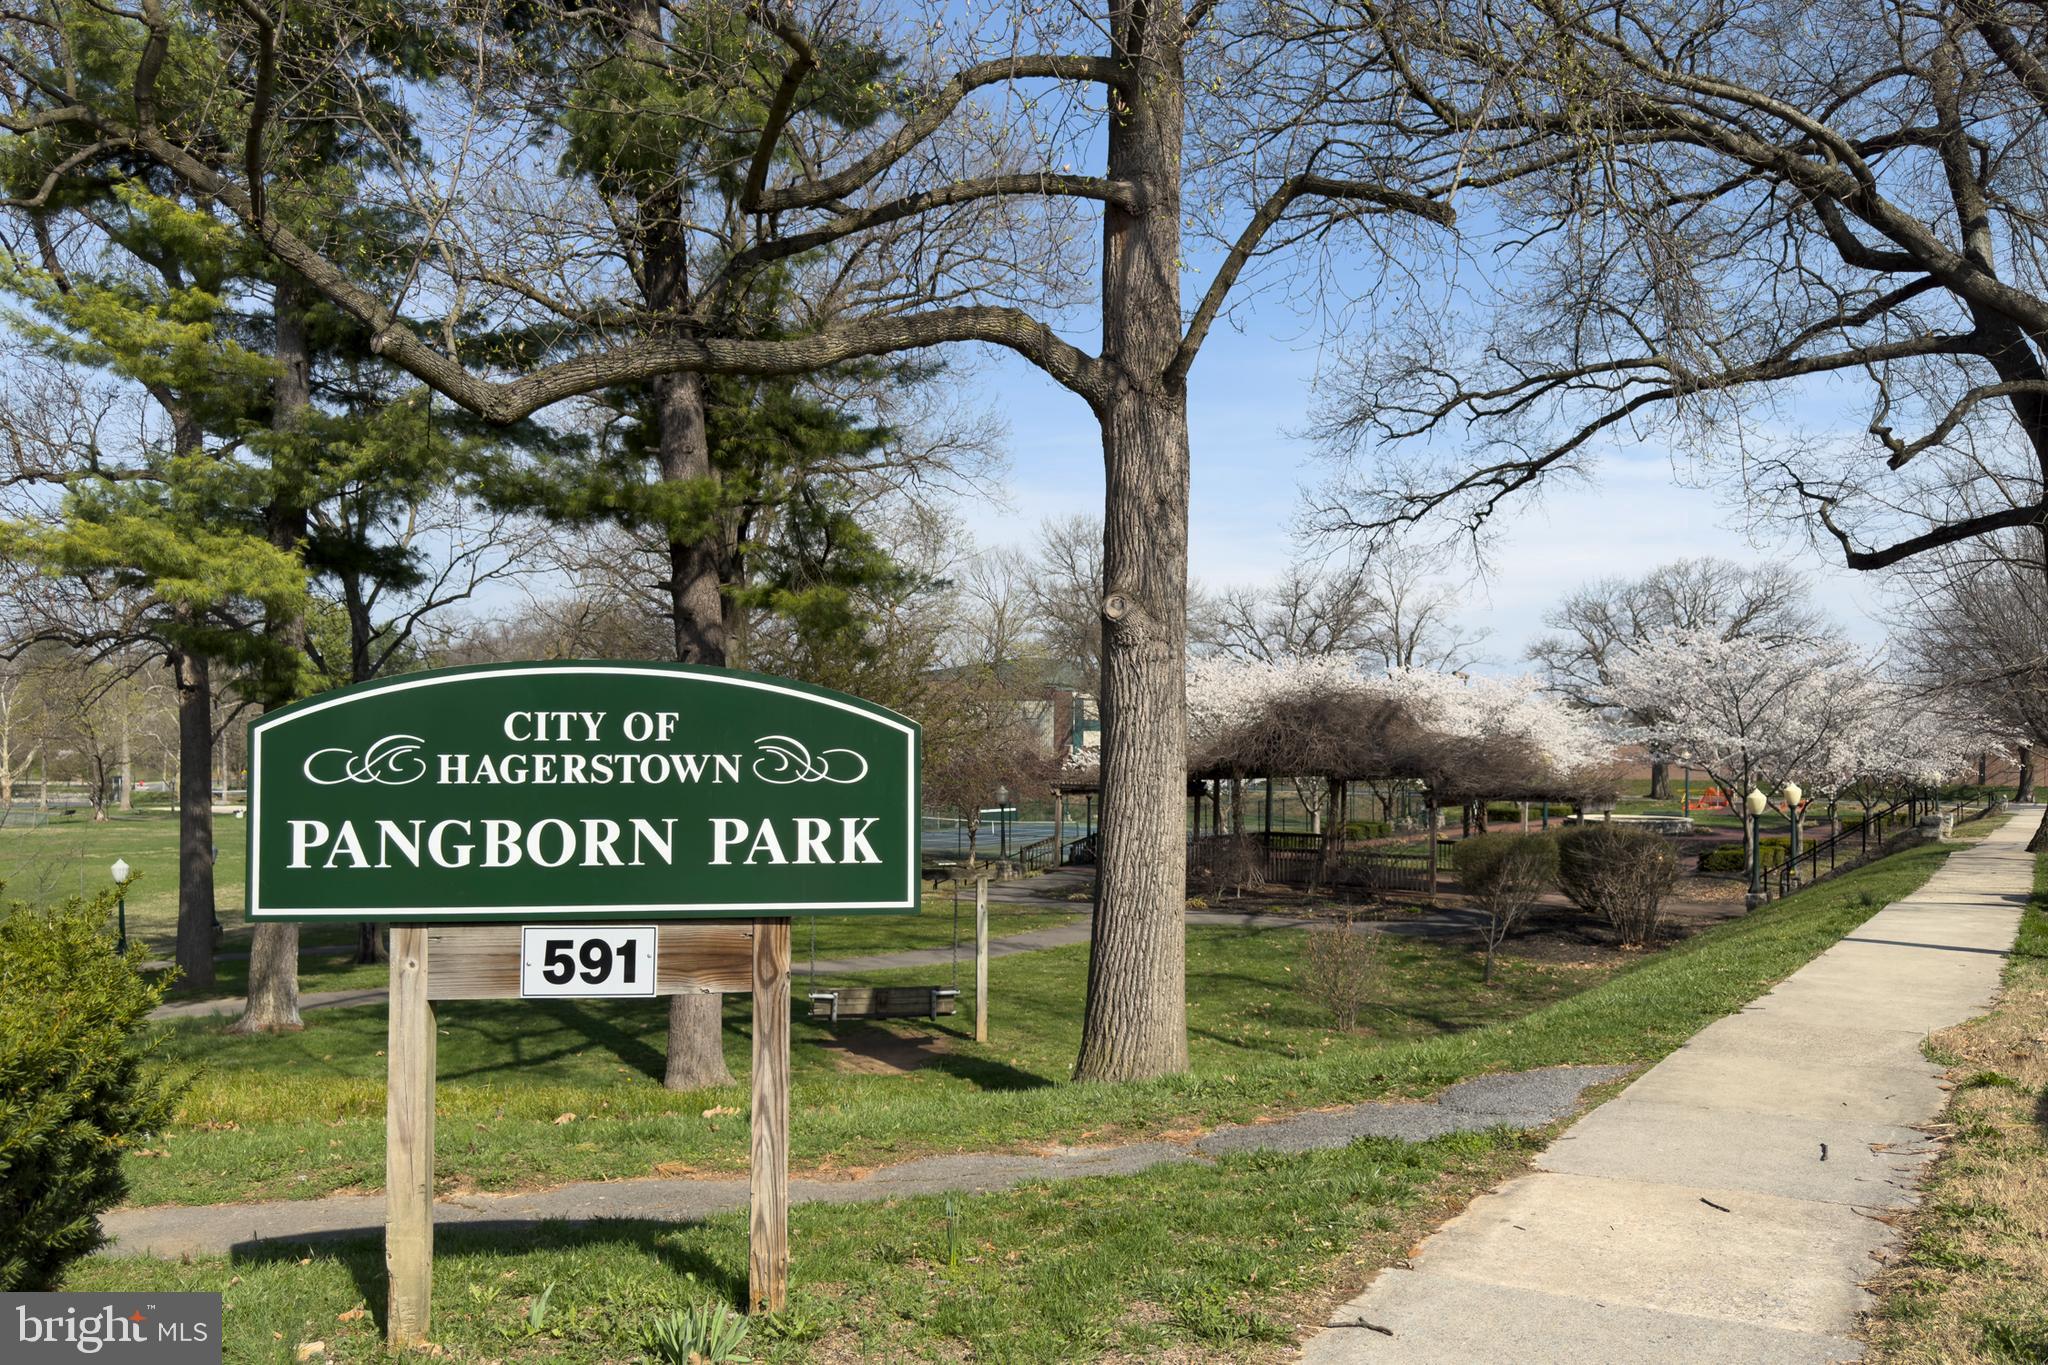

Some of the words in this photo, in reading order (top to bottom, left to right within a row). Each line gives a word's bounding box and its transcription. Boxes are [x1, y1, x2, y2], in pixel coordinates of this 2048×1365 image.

[503, 711, 606, 742] CITY
[623, 711, 680, 742] OF
[437, 753, 742, 785] HAGERSTOWN
[286, 818, 679, 869] PANGBORN
[708, 817, 883, 865] PARK
[542, 938, 637, 985] 591
